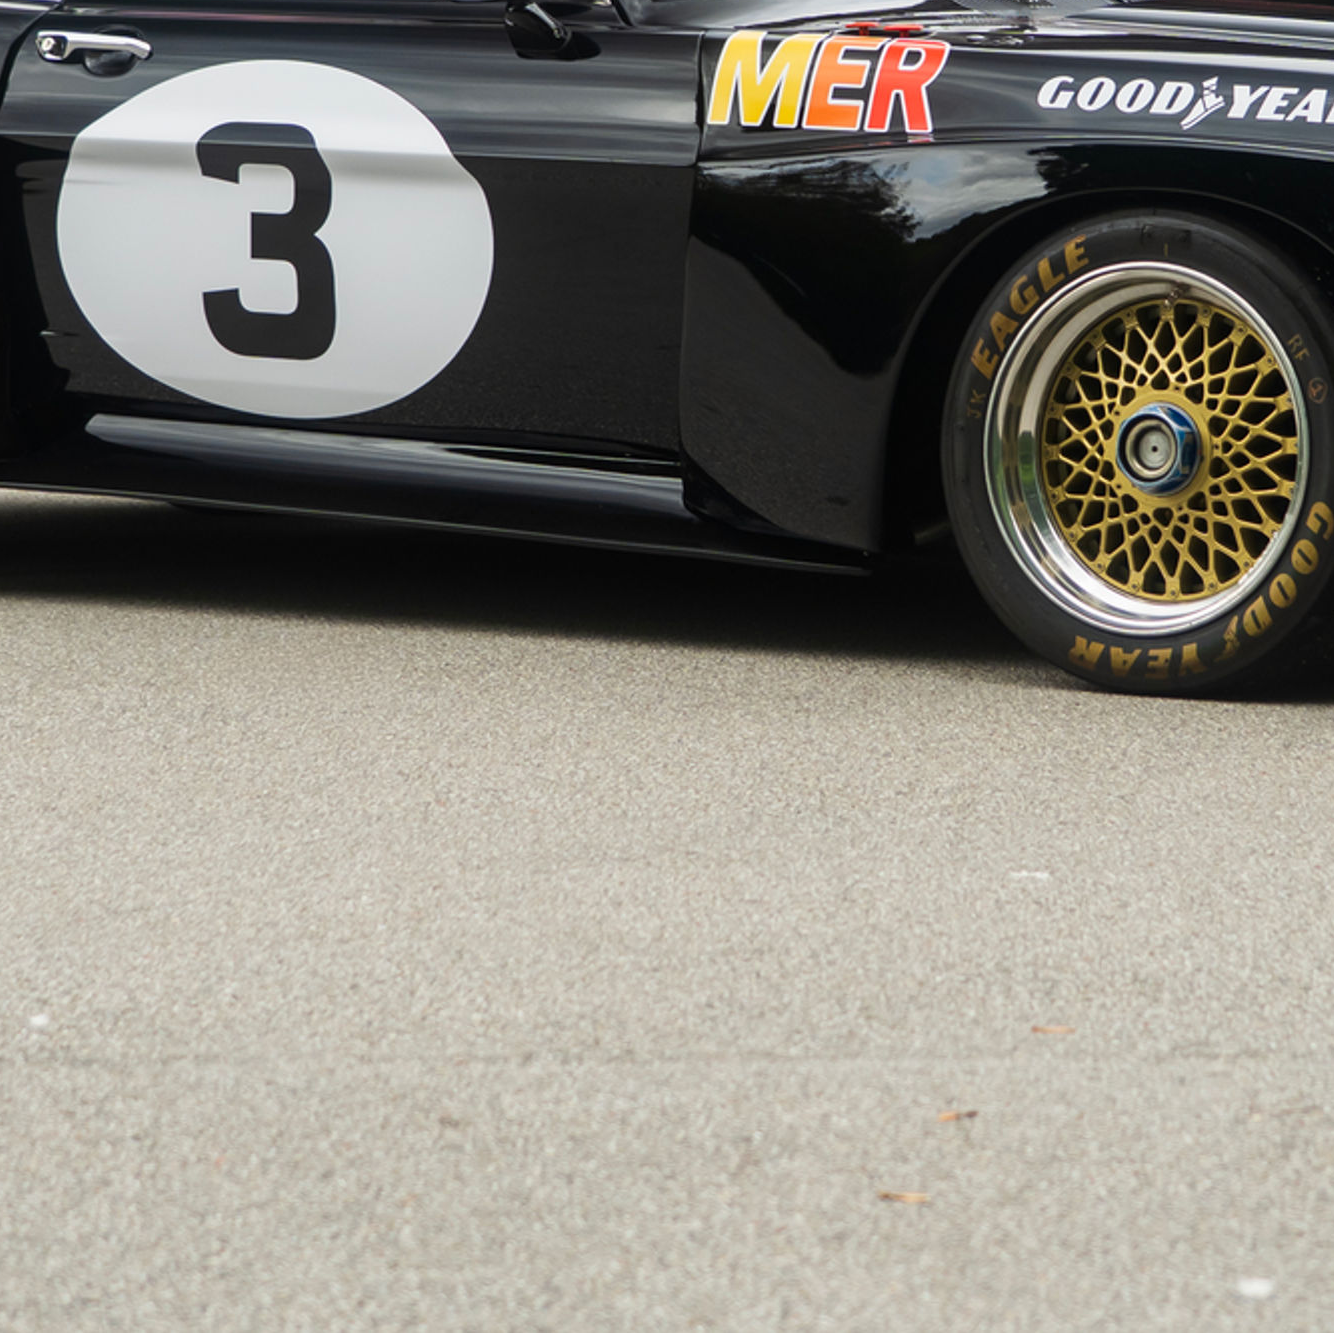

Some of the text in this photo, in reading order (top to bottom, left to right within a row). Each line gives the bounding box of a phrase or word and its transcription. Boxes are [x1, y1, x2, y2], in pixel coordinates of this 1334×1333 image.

[705, 28, 952, 134] MER
[195, 121, 337, 361] 3
[970, 233, 1090, 380] EAGLE
